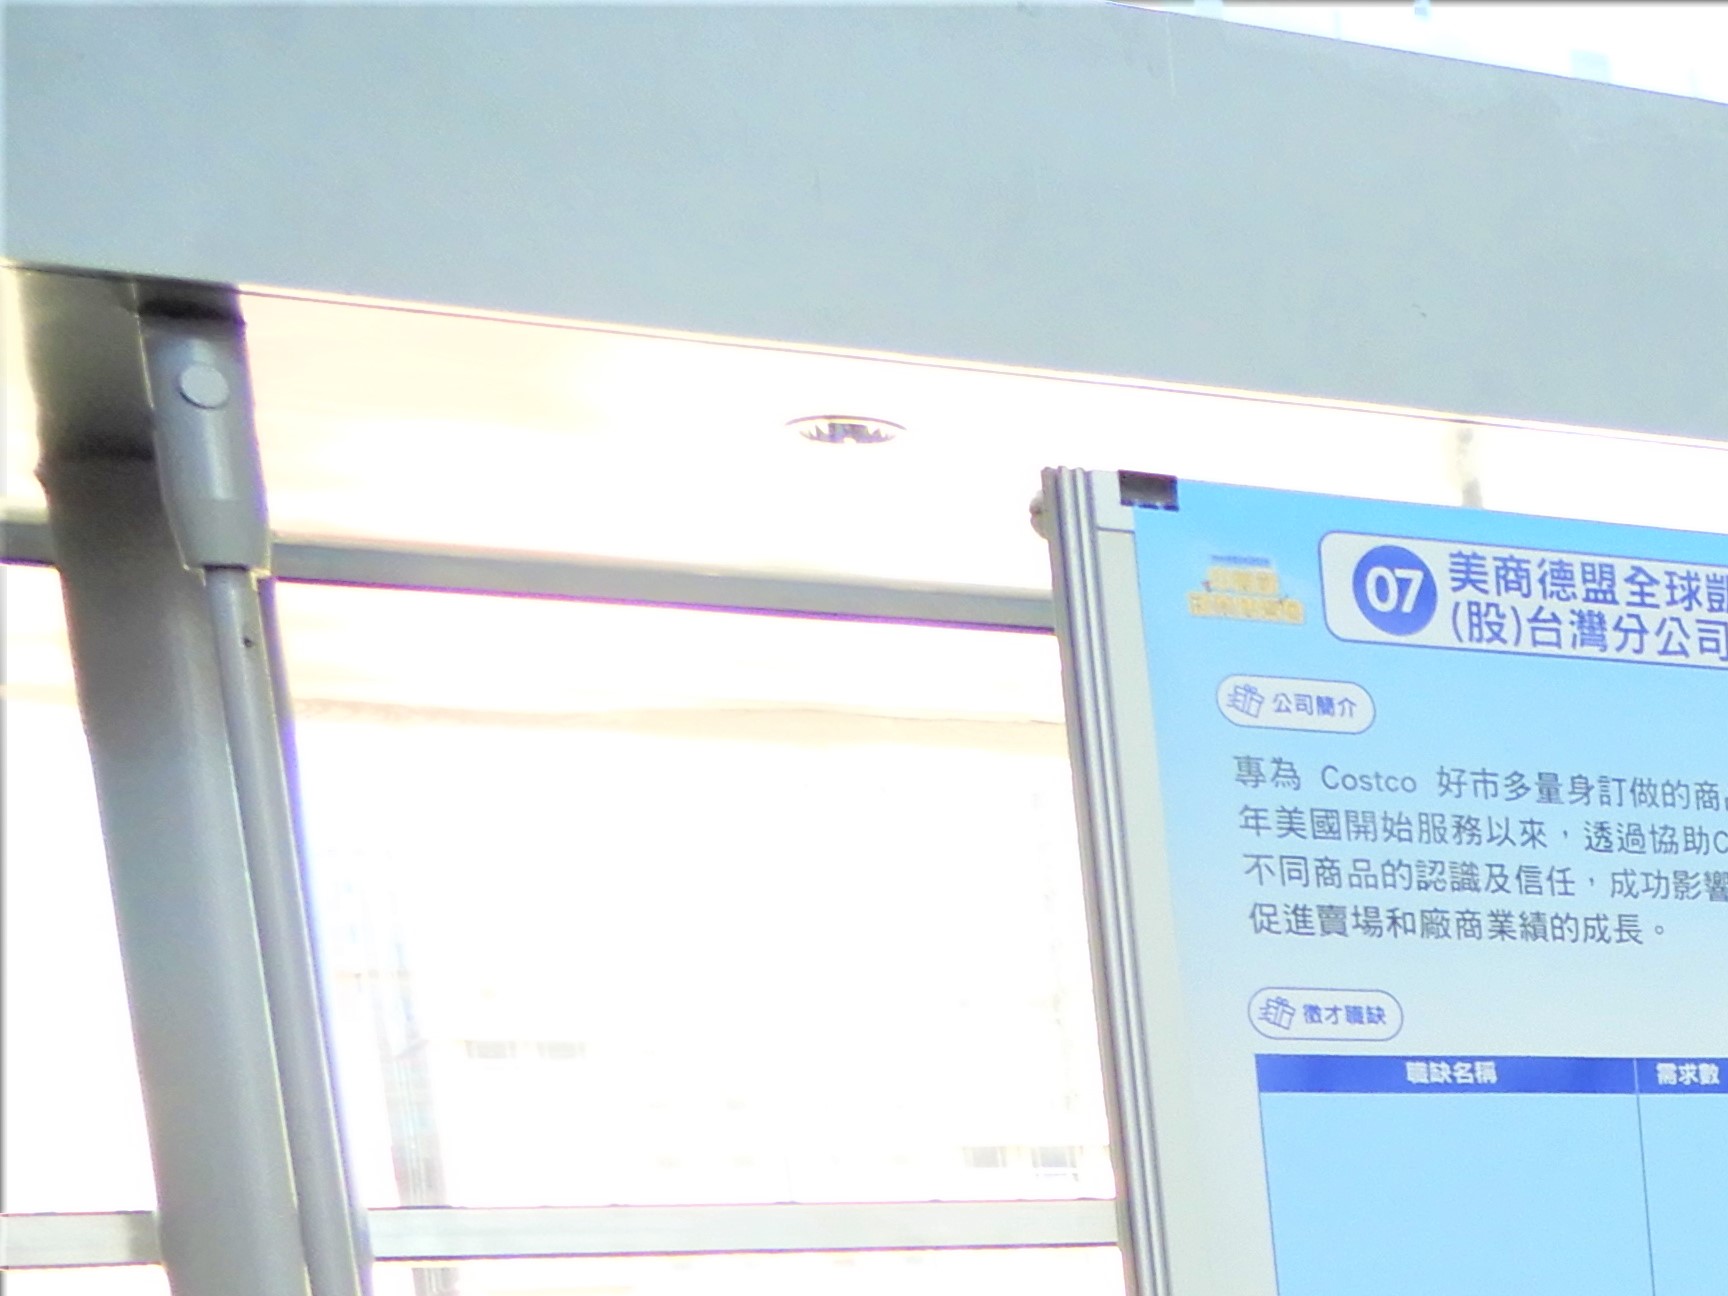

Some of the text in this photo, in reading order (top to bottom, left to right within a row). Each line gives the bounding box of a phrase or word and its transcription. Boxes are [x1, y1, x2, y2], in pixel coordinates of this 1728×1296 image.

[1365, 565, 1425, 613] 07
[1272, 692, 1358, 719] 公司簡介
[1232, 753, 1302, 793] 專為
[1320, 764, 1418, 795] Costco
[1302, 1002, 1388, 1028] 徵才職缺
[1405, 1062, 1498, 1087] 職缺名稱
[1656, 1062, 1721, 1088] 需求數
